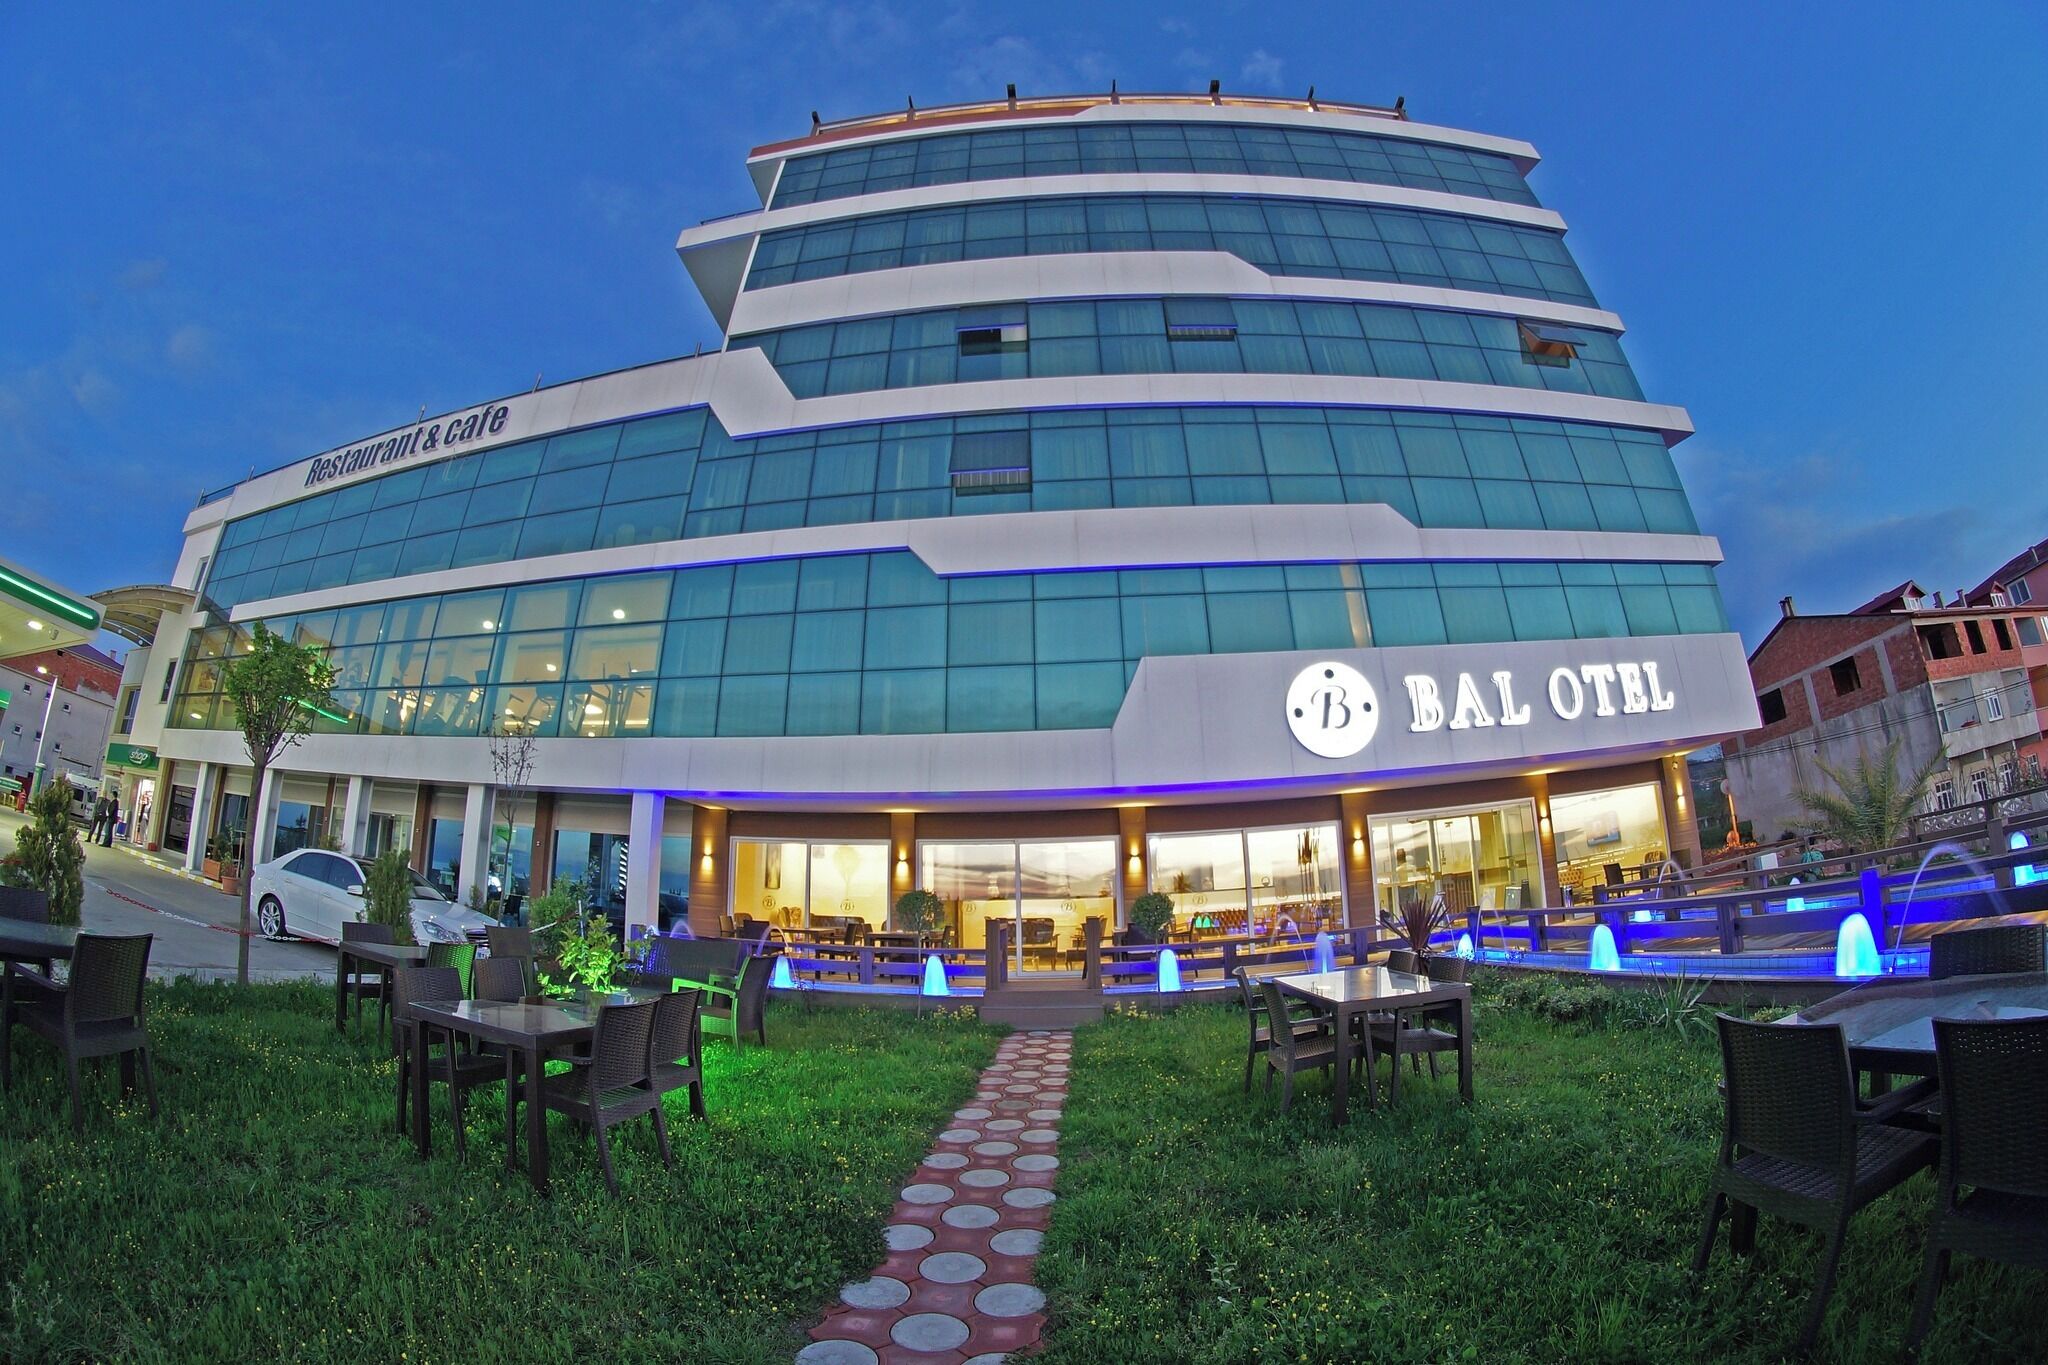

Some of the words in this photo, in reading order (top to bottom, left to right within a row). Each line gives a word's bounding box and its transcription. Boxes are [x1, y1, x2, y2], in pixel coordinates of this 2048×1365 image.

[304, 426, 424, 487] Restaurant
[422, 424, 441, 451] &
[1310, 684, 1352, 730] B
[1402, 671, 1532, 732] BAL
[1547, 661, 1675, 721] OTEL
[129, 748, 149, 763] shop
